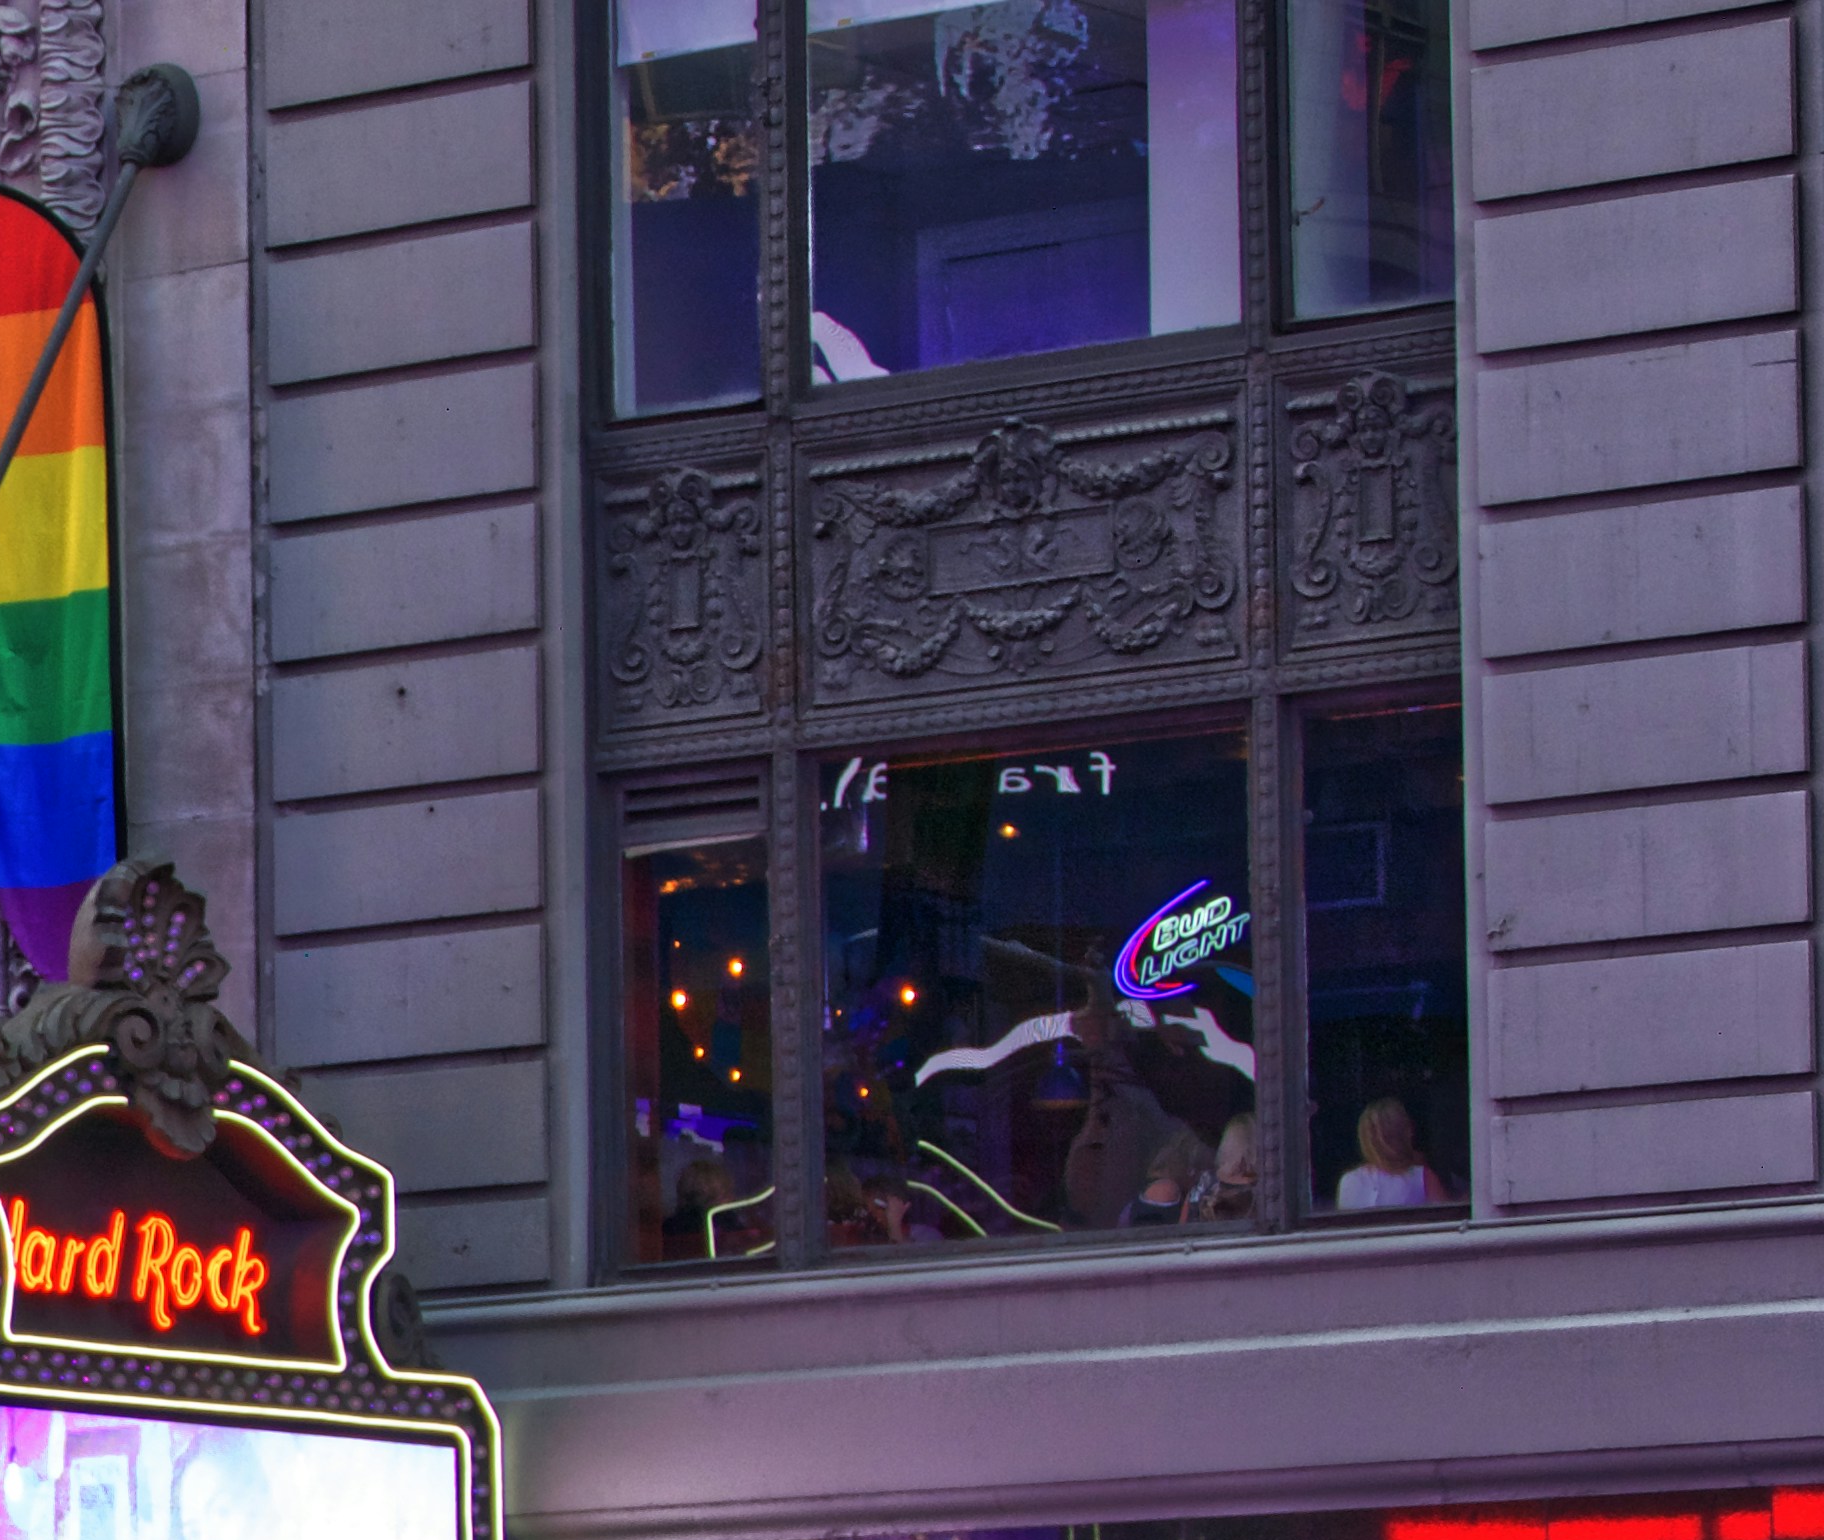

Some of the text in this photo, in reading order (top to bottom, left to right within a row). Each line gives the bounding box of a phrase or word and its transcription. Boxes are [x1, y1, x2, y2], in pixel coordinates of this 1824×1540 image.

[1140, 912, 1250, 985] LIGHT
[1152, 896, 1232, 951] BUD
[135, 1213, 267, 1333] Rock
